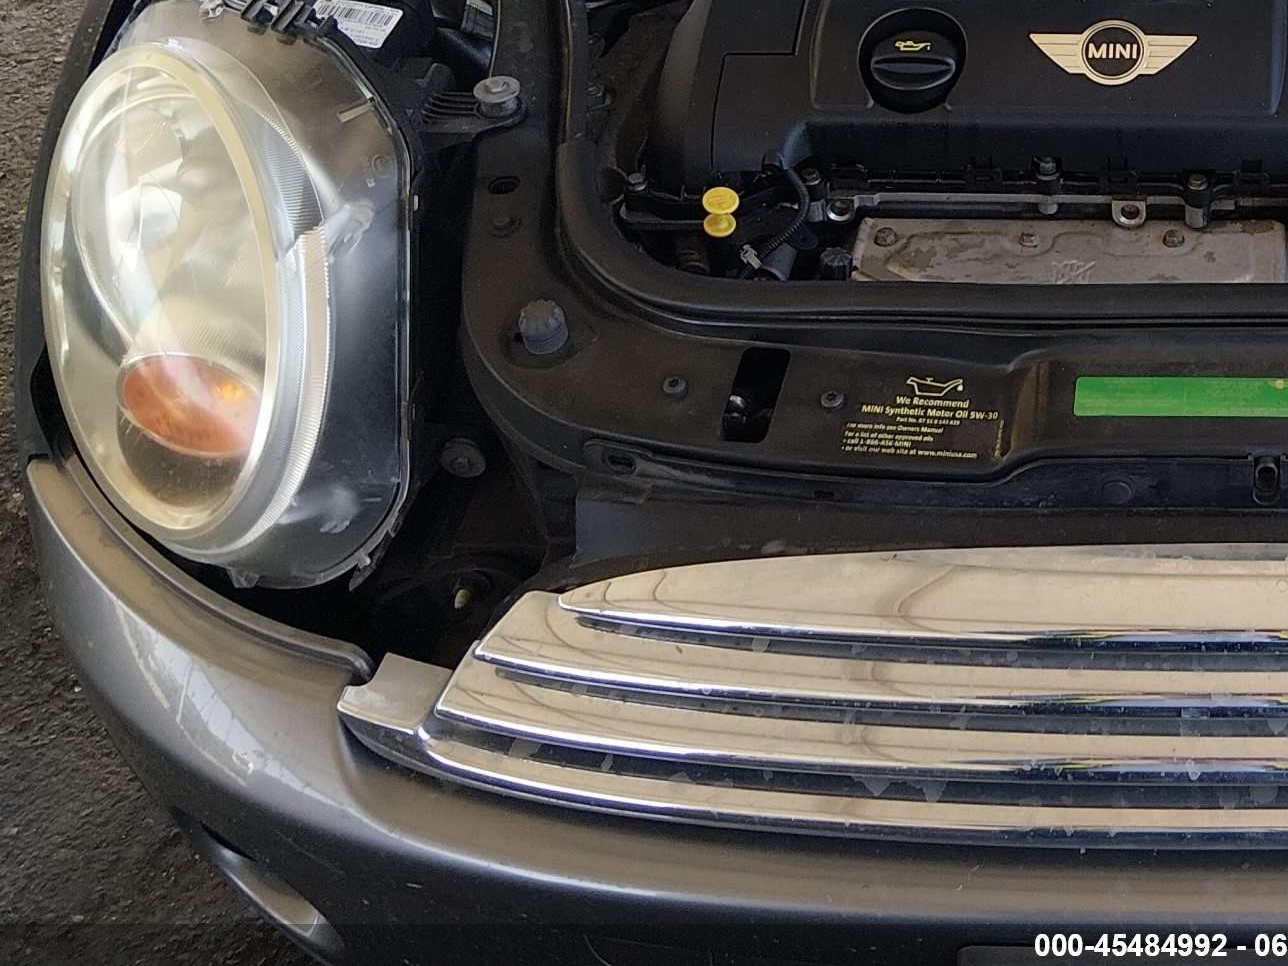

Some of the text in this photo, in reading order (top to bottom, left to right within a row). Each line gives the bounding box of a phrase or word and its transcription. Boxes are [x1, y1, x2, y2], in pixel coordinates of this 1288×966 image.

[1088, 43, 1138, 59] MINI
[896, 396, 969, 408] We Recommend
[861, 405, 998, 420] MINI Synthetic Motor Oil 5W-30
[895, 434, 922, 442] approved
[918, 450, 977, 459] www.miniusa.com
